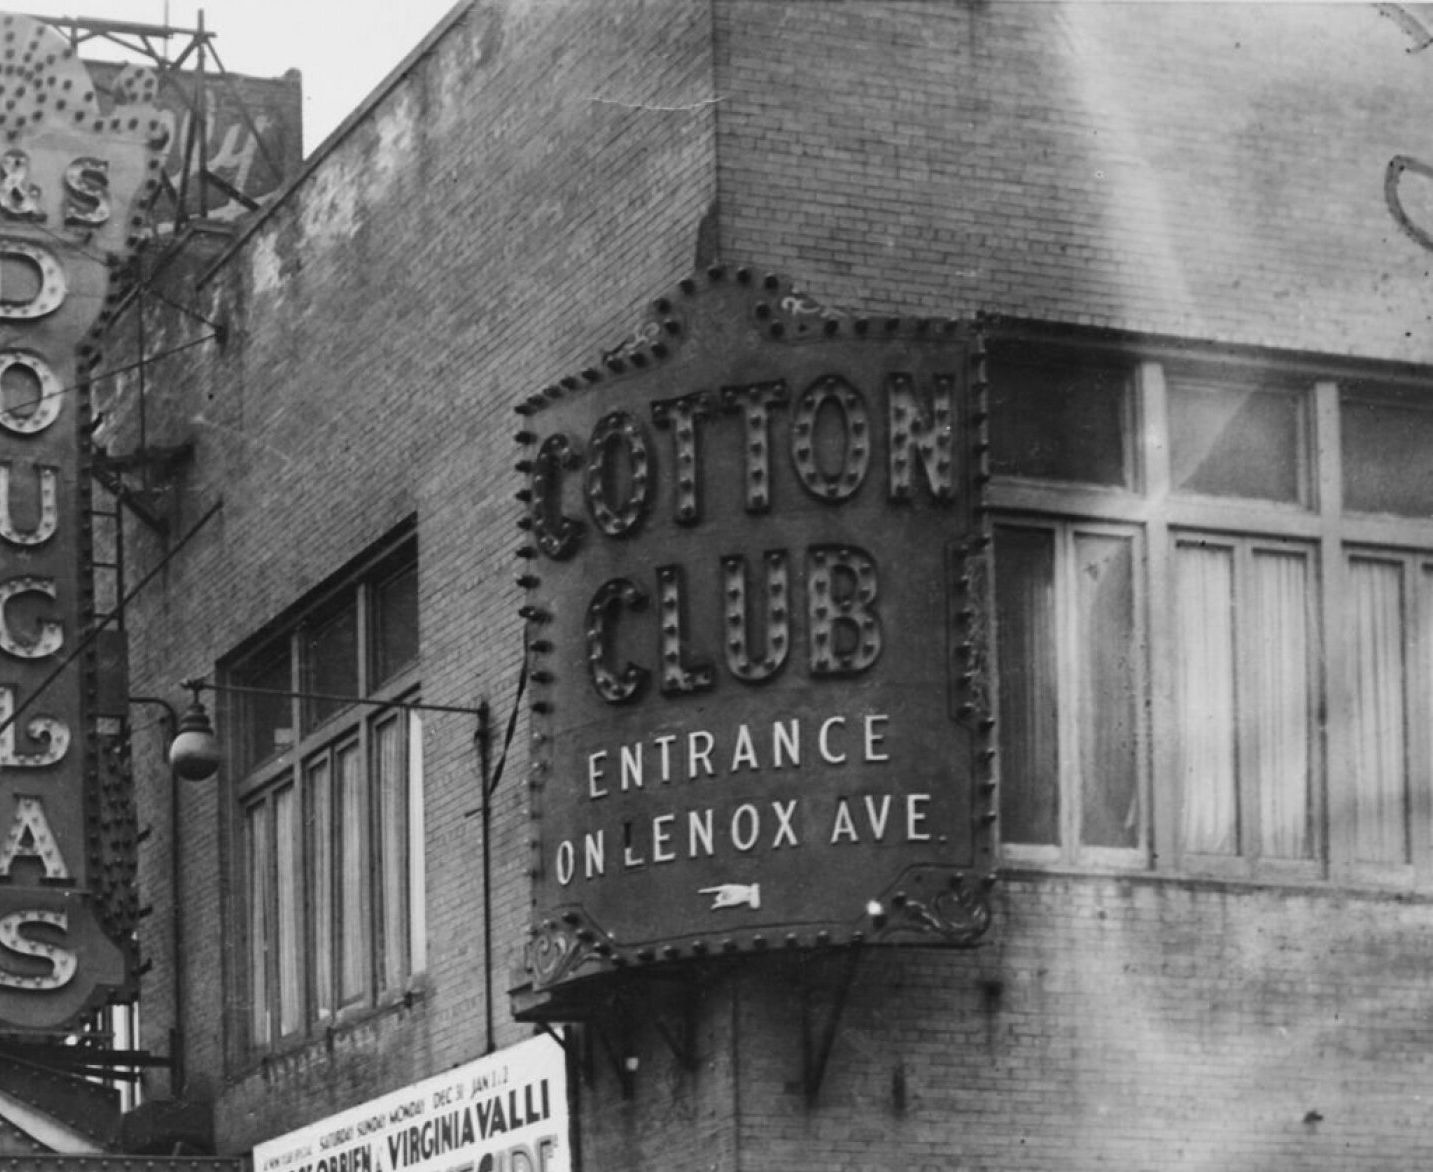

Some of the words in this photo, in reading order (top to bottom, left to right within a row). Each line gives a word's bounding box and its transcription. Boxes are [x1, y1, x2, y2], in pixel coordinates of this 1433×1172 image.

[532, 372, 957, 561] COTTON
[584, 543, 884, 702] CLUB
[587, 714, 891, 799] ENTRANCE
[555, 828, 605, 885] ON
[624, 799, 799, 868] LENOX
[387, 1106, 475, 1171] VIRGINIA
[476, 1078, 551, 1141] VALLI
